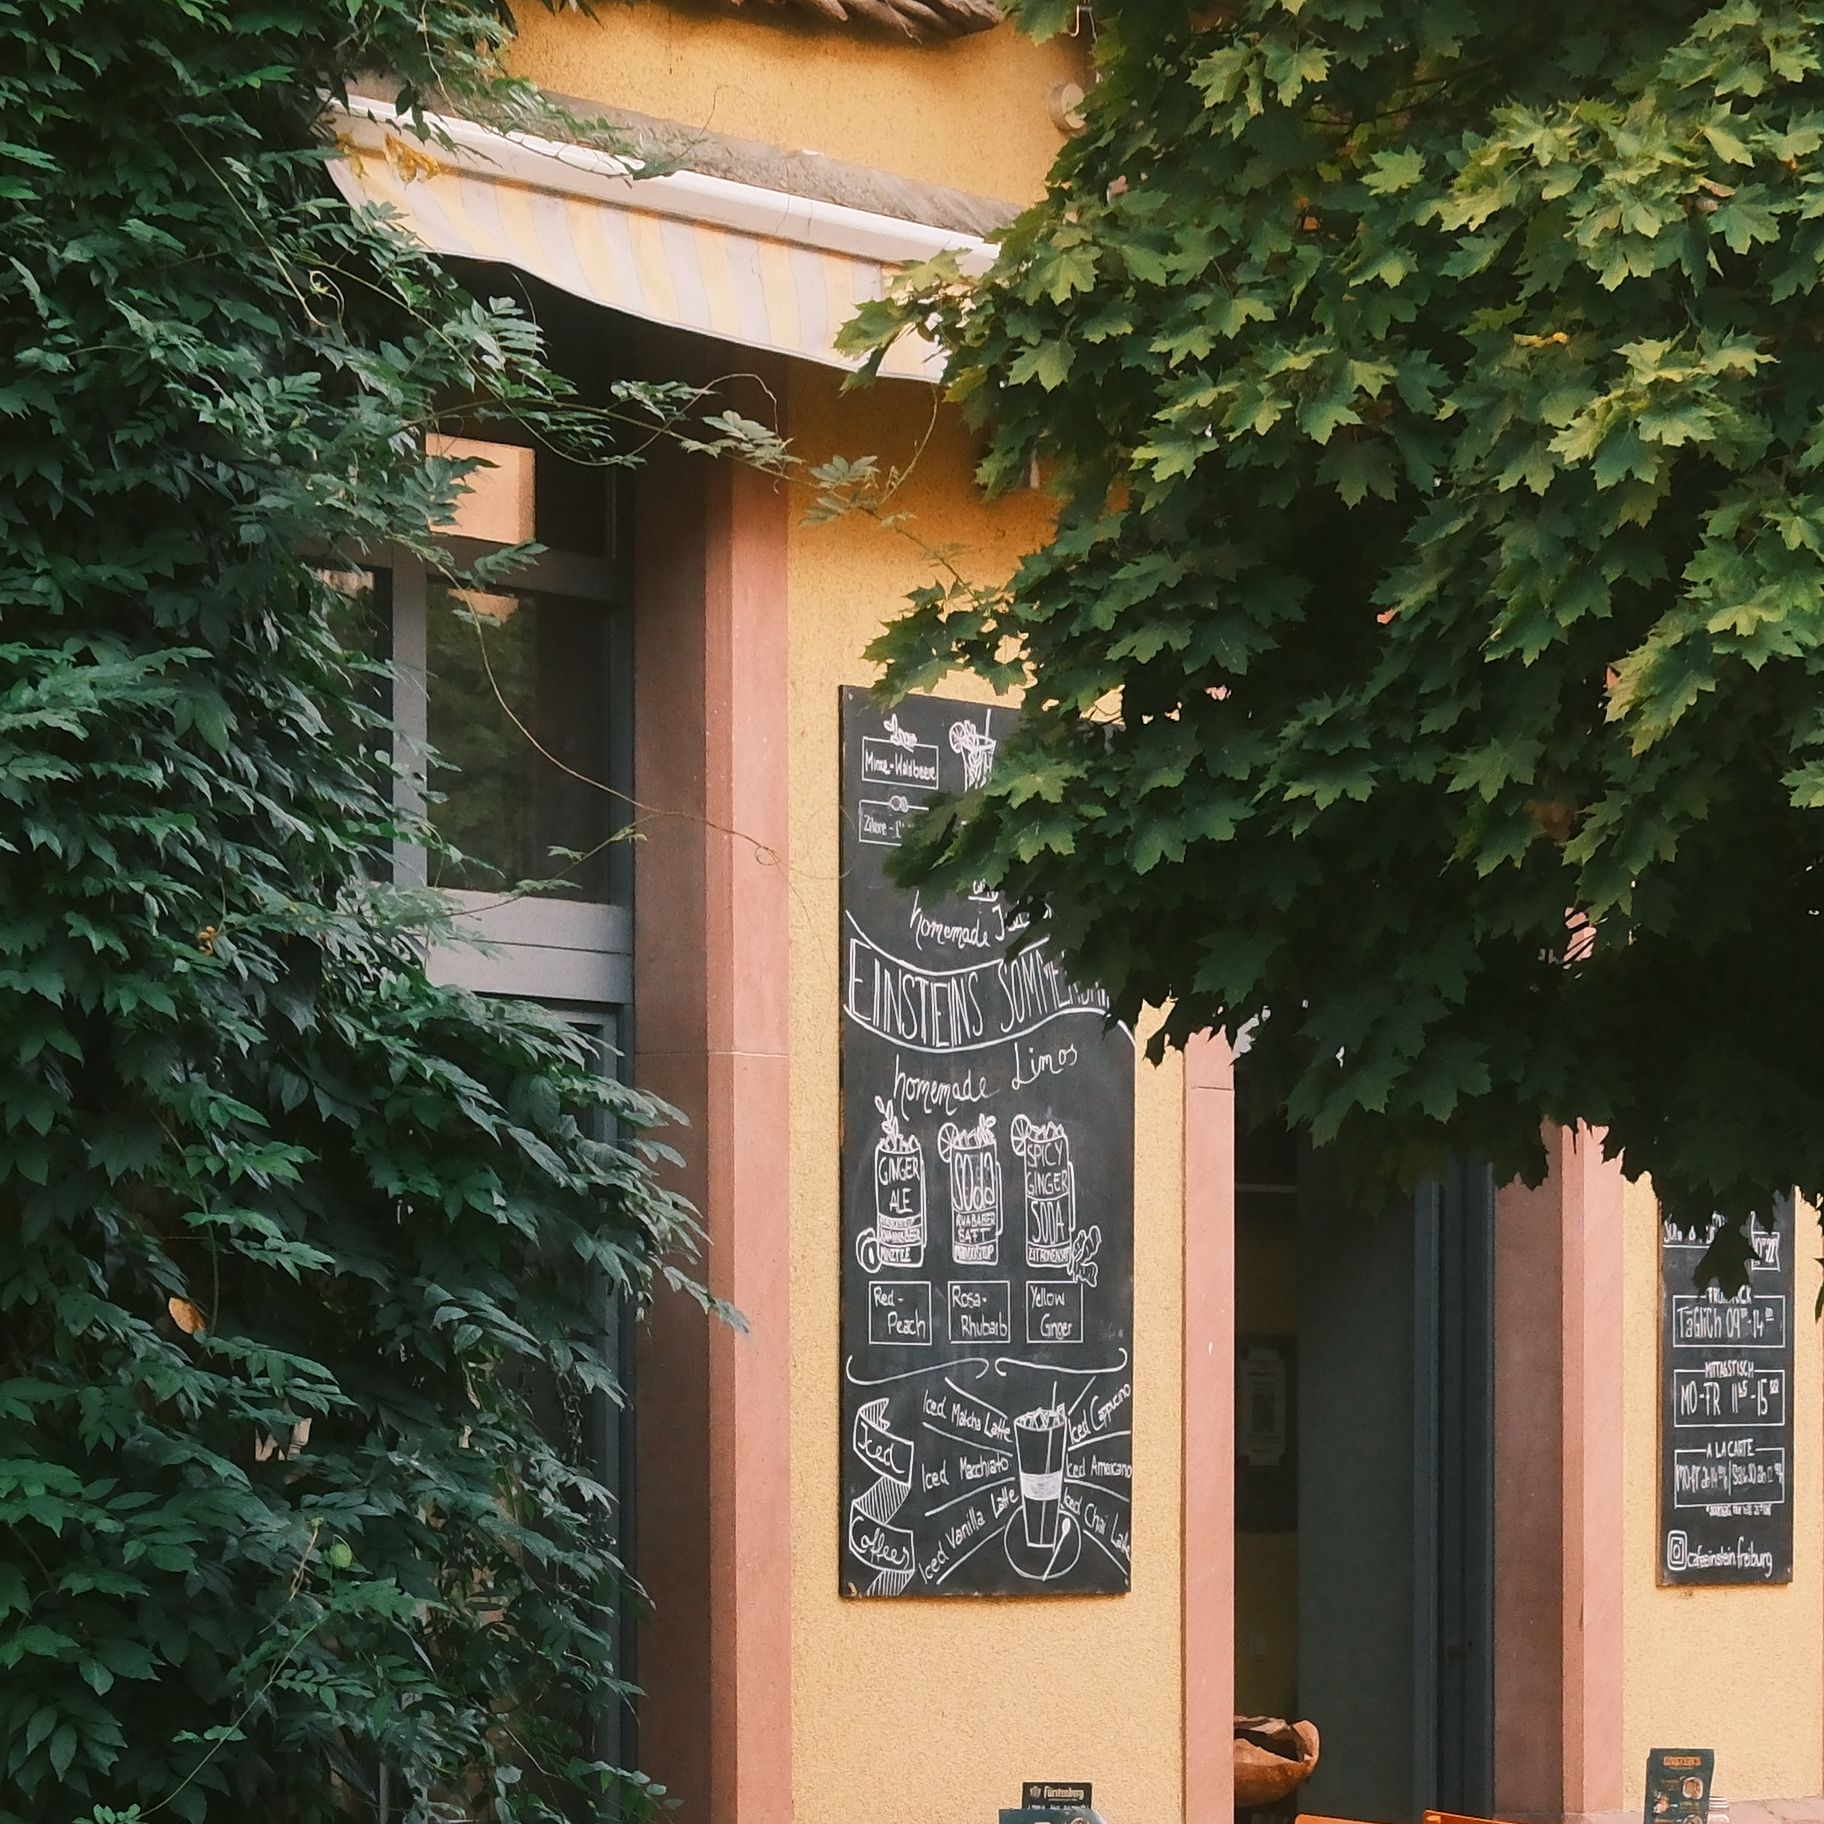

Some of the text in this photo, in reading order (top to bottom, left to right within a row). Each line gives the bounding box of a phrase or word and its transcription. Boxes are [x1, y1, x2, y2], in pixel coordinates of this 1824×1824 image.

[910, 890, 991, 950] homemade
[848, 938, 984, 1048] EINSTEINS
[893, 1042, 1078, 1121] homemade Limos
[878, 1156, 921, 1186] GINGER
[1026, 1140, 1064, 1168] SPICY
[889, 1188, 914, 1214] ALE
[1025, 1170, 1069, 1197] GINGER
[1030, 1201, 1065, 1244] SODA
[1030, 1285, 1065, 1308] Yellow
[887, 1309, 926, 1339] Peach
[961, 1311, 1008, 1338] Rhubarb
[1040, 1313, 1073, 1341] Ginger
[923, 1389, 1013, 1443] Iced Matcha Latte
[1067, 1409, 1092, 1445] Iced
[857, 1421, 905, 1475] Iced
[1065, 1453, 1086, 1478] Iced
[921, 1452, 1010, 1493] Iced Macchiato
[1060, 1487, 1083, 1516] Iced
[1084, 1503, 1108, 1536] Chai
[918, 1486, 1020, 1584] Iced Vanilla Latte
